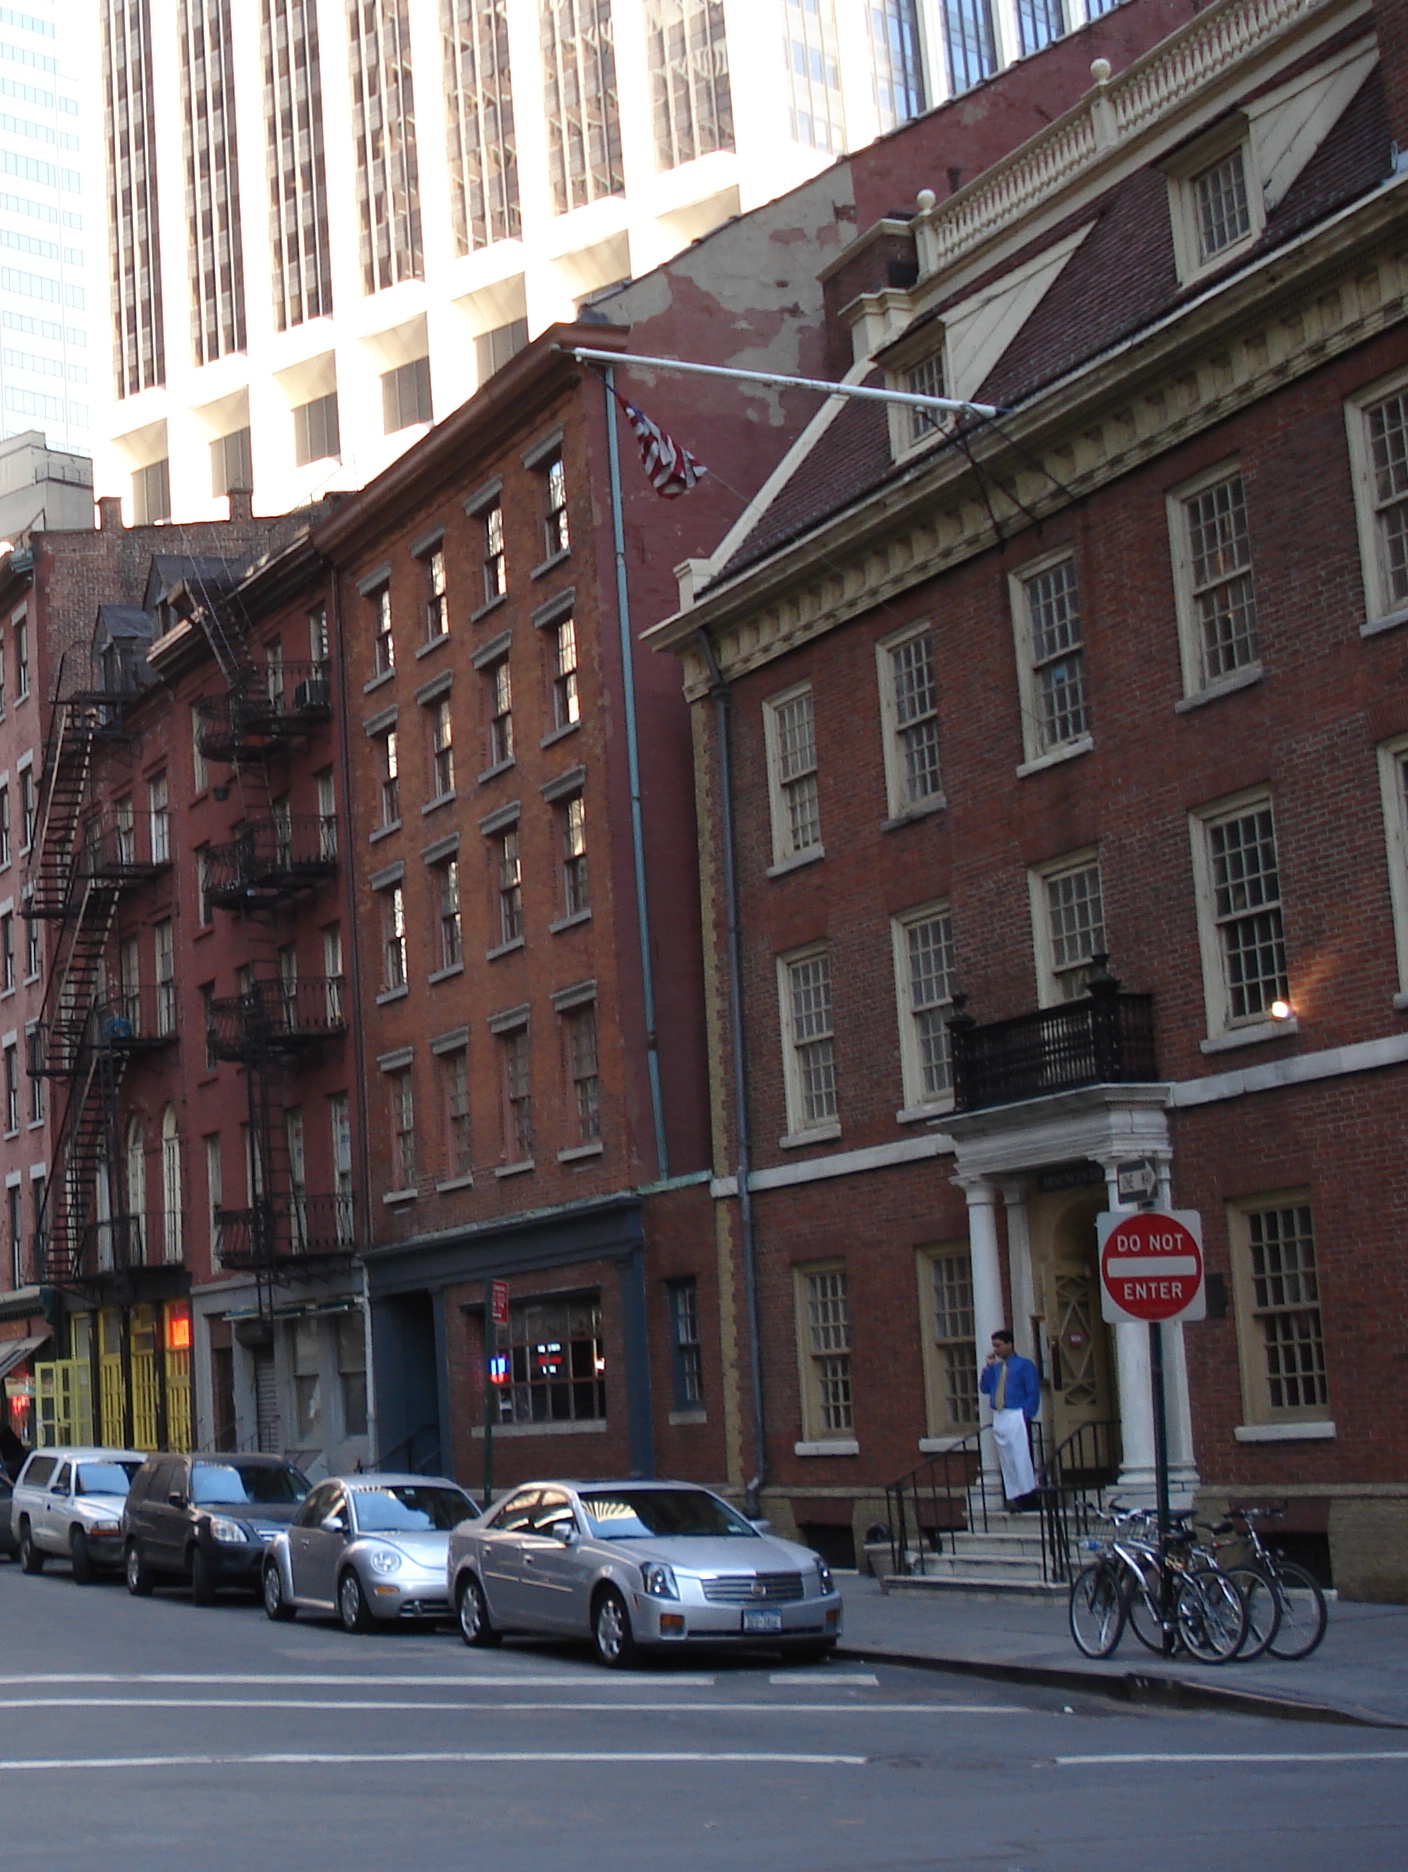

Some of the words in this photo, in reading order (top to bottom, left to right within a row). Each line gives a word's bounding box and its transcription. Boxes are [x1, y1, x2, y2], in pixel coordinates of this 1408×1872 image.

[1117, 1234, 1141, 1253] DO
[1148, 1233, 1184, 1251] NOT
[1123, 1282, 1184, 1301] ENTER
